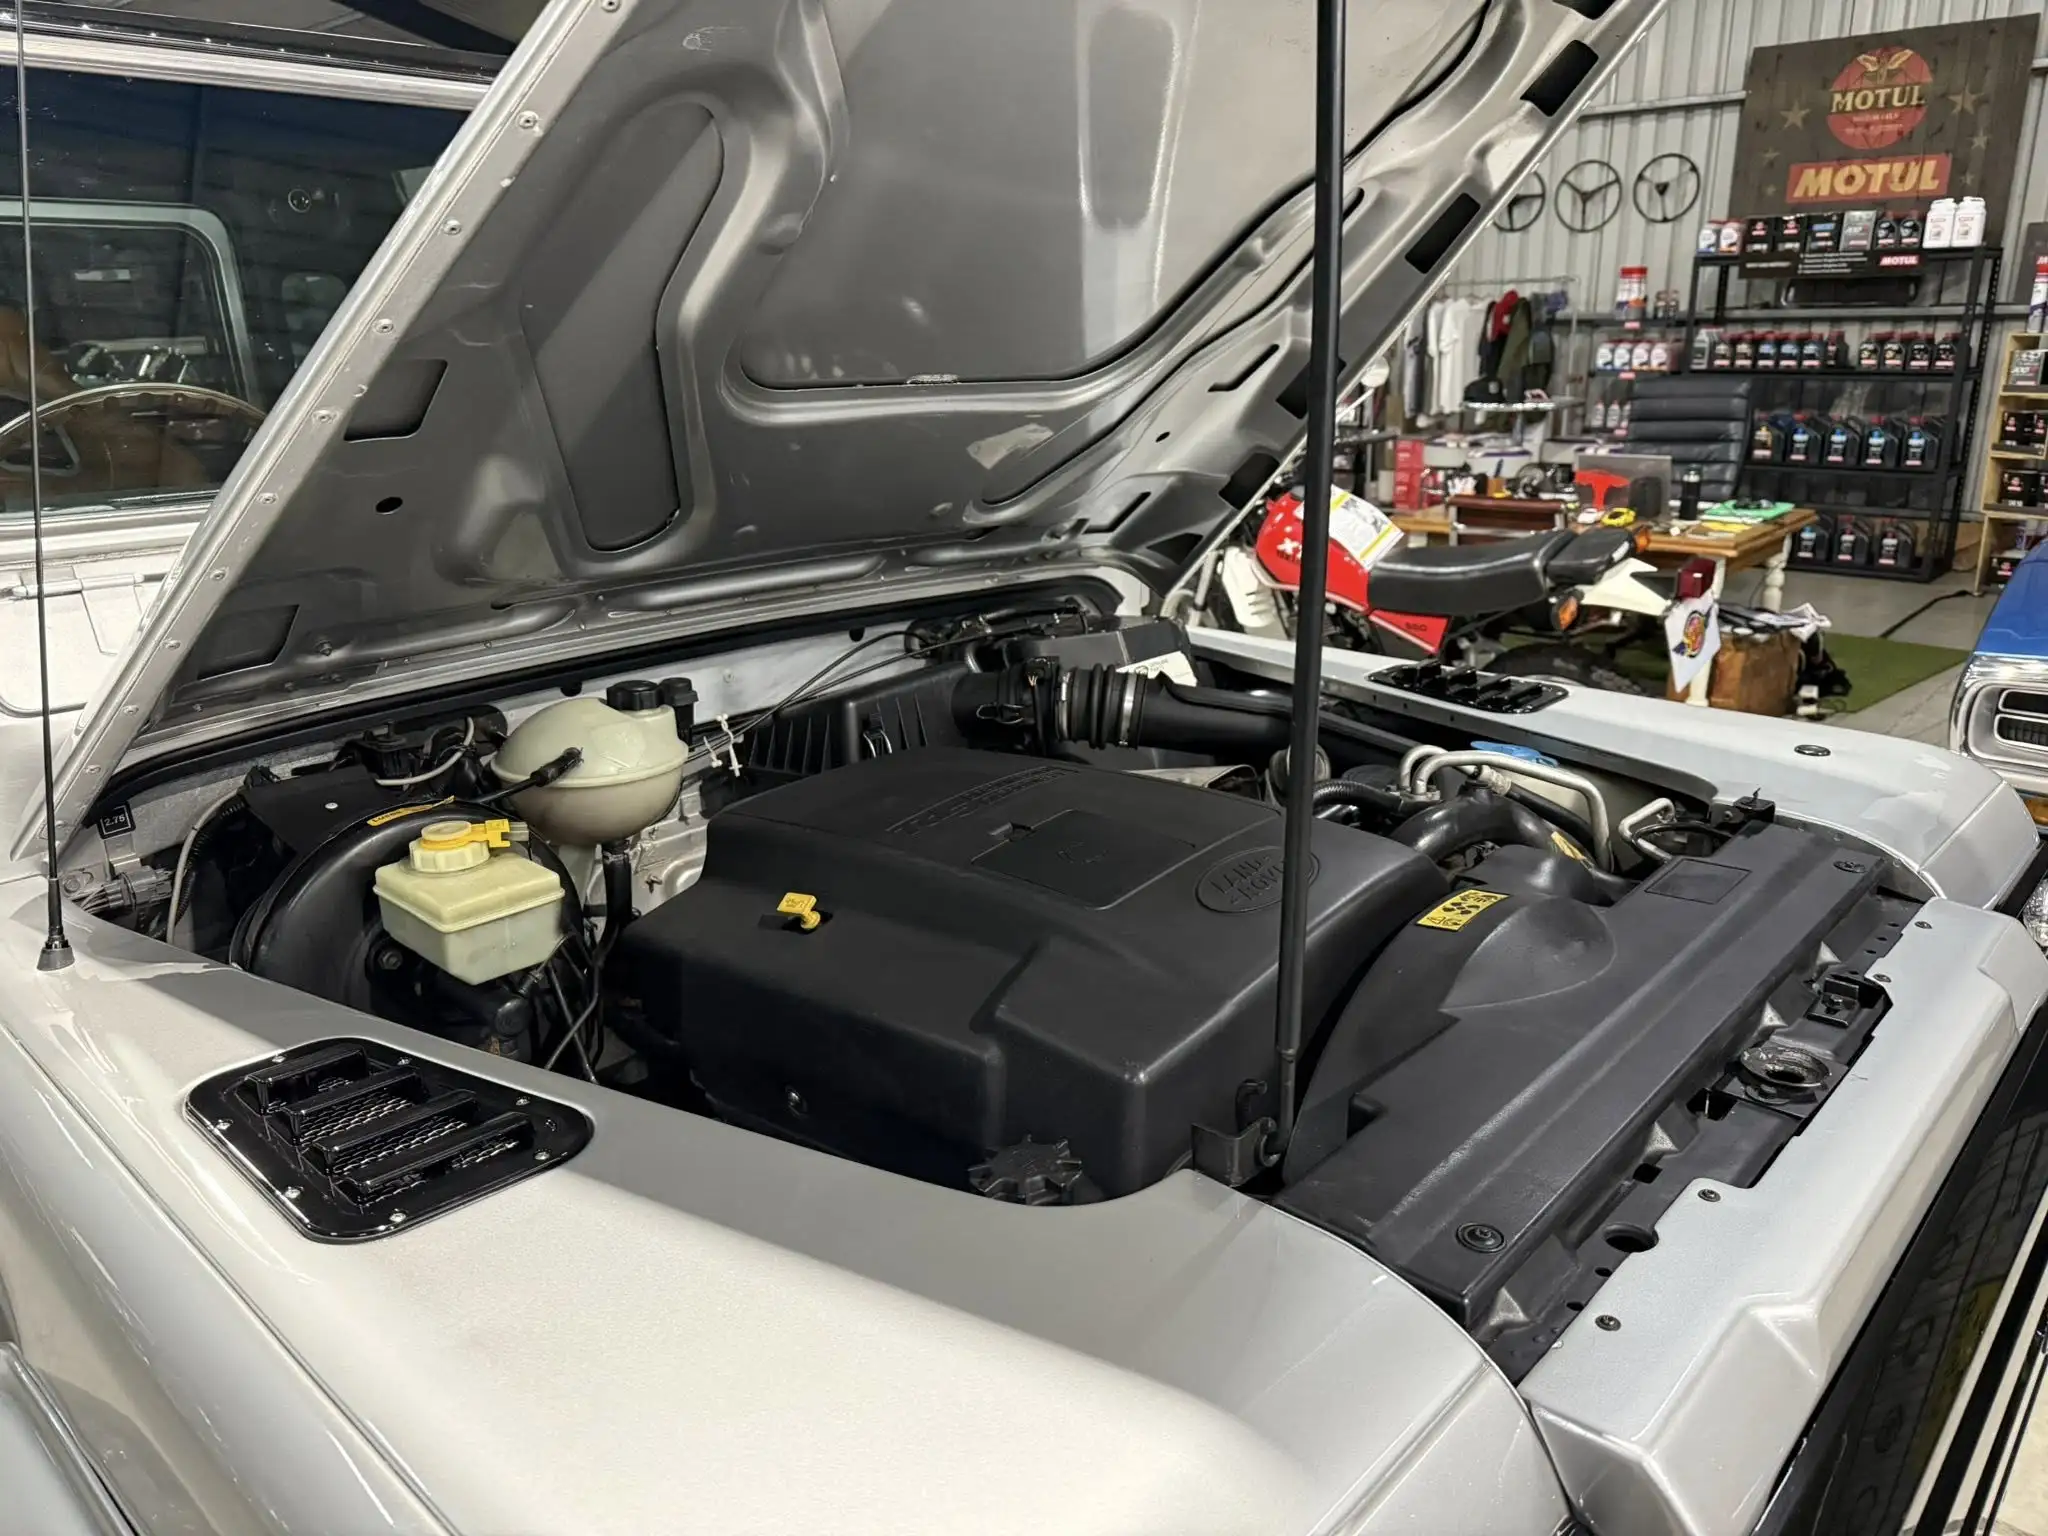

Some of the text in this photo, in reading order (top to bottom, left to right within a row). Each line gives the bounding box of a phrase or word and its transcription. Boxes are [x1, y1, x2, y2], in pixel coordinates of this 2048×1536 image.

[1830, 85, 1926, 113] MOTUL
[1793, 160, 1940, 198] MOTUL
[1880, 255, 1918, 266] MOTUL
[104, 814, 126, 826] 2.75
[1209, 855, 1272, 895] LAND
